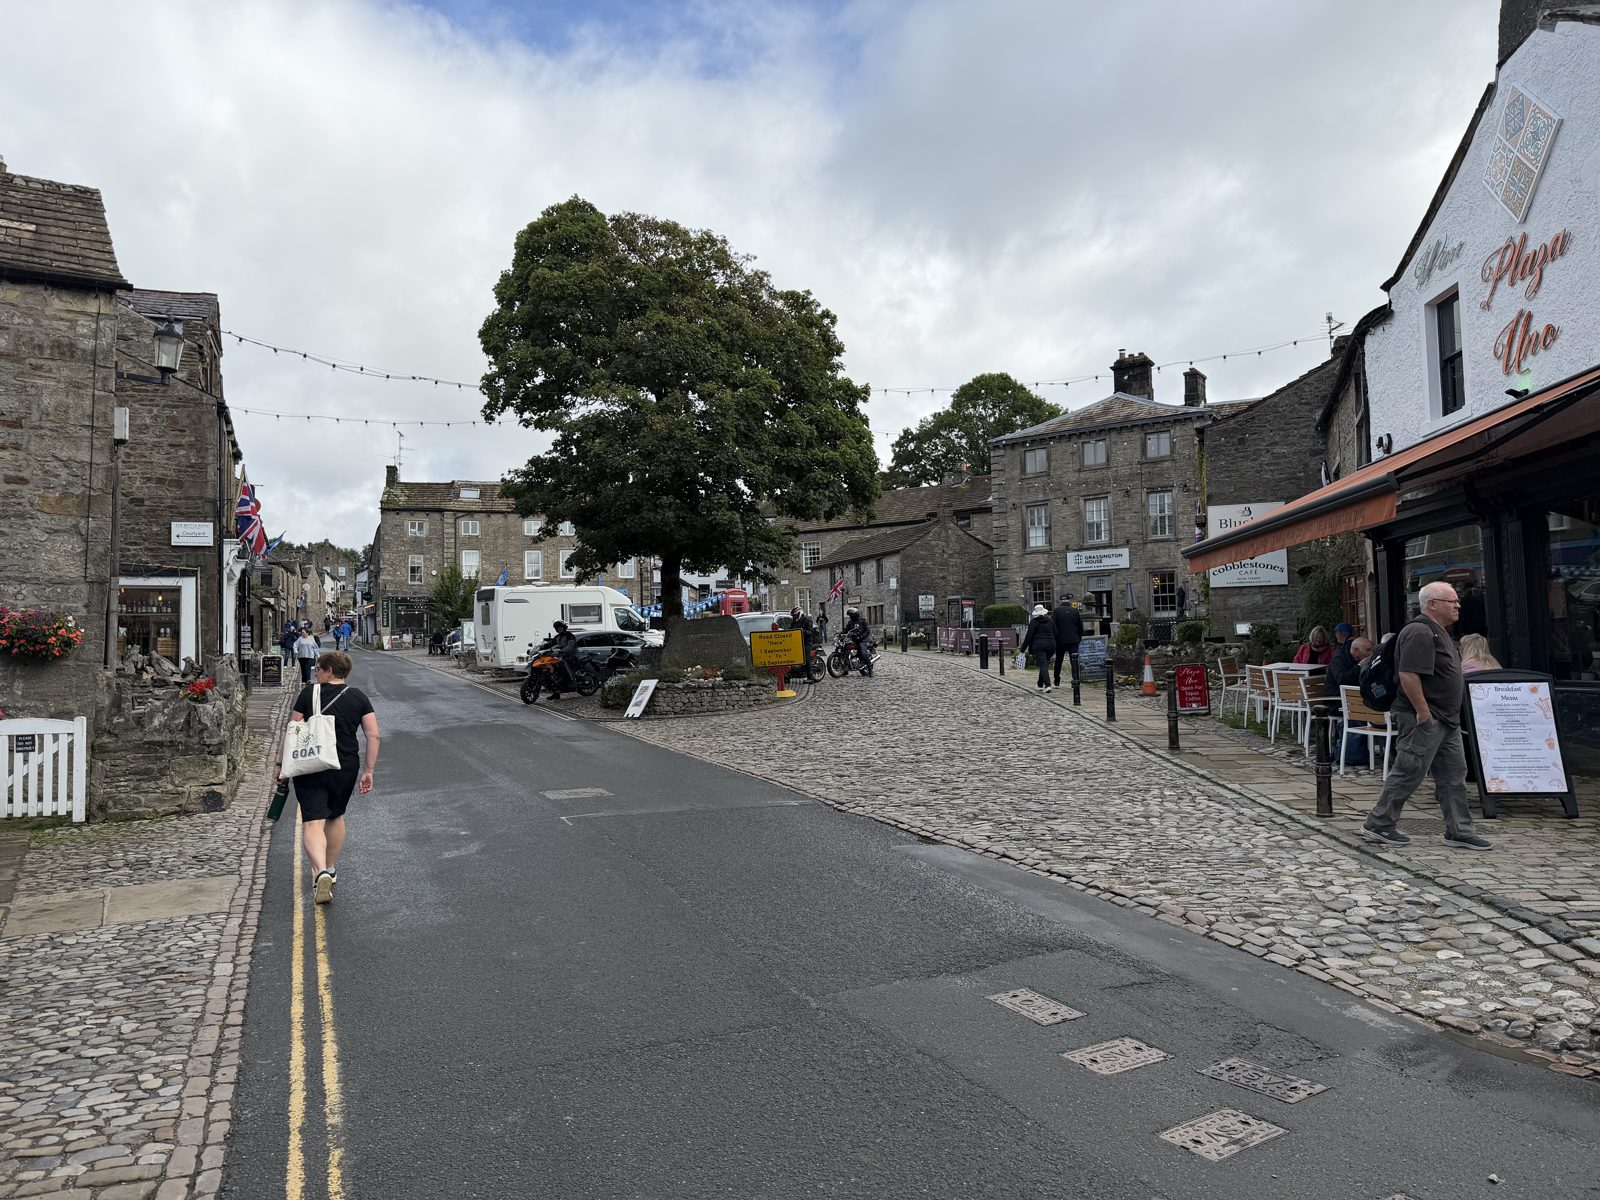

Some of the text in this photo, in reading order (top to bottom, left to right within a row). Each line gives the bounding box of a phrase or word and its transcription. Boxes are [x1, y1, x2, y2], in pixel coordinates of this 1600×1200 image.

[1480, 228, 1573, 311] Plaza
[1493, 308, 1560, 375] Uno
[1212, 561, 1285, 577] cobblestones
[292, 745, 322, 759] GOAT
